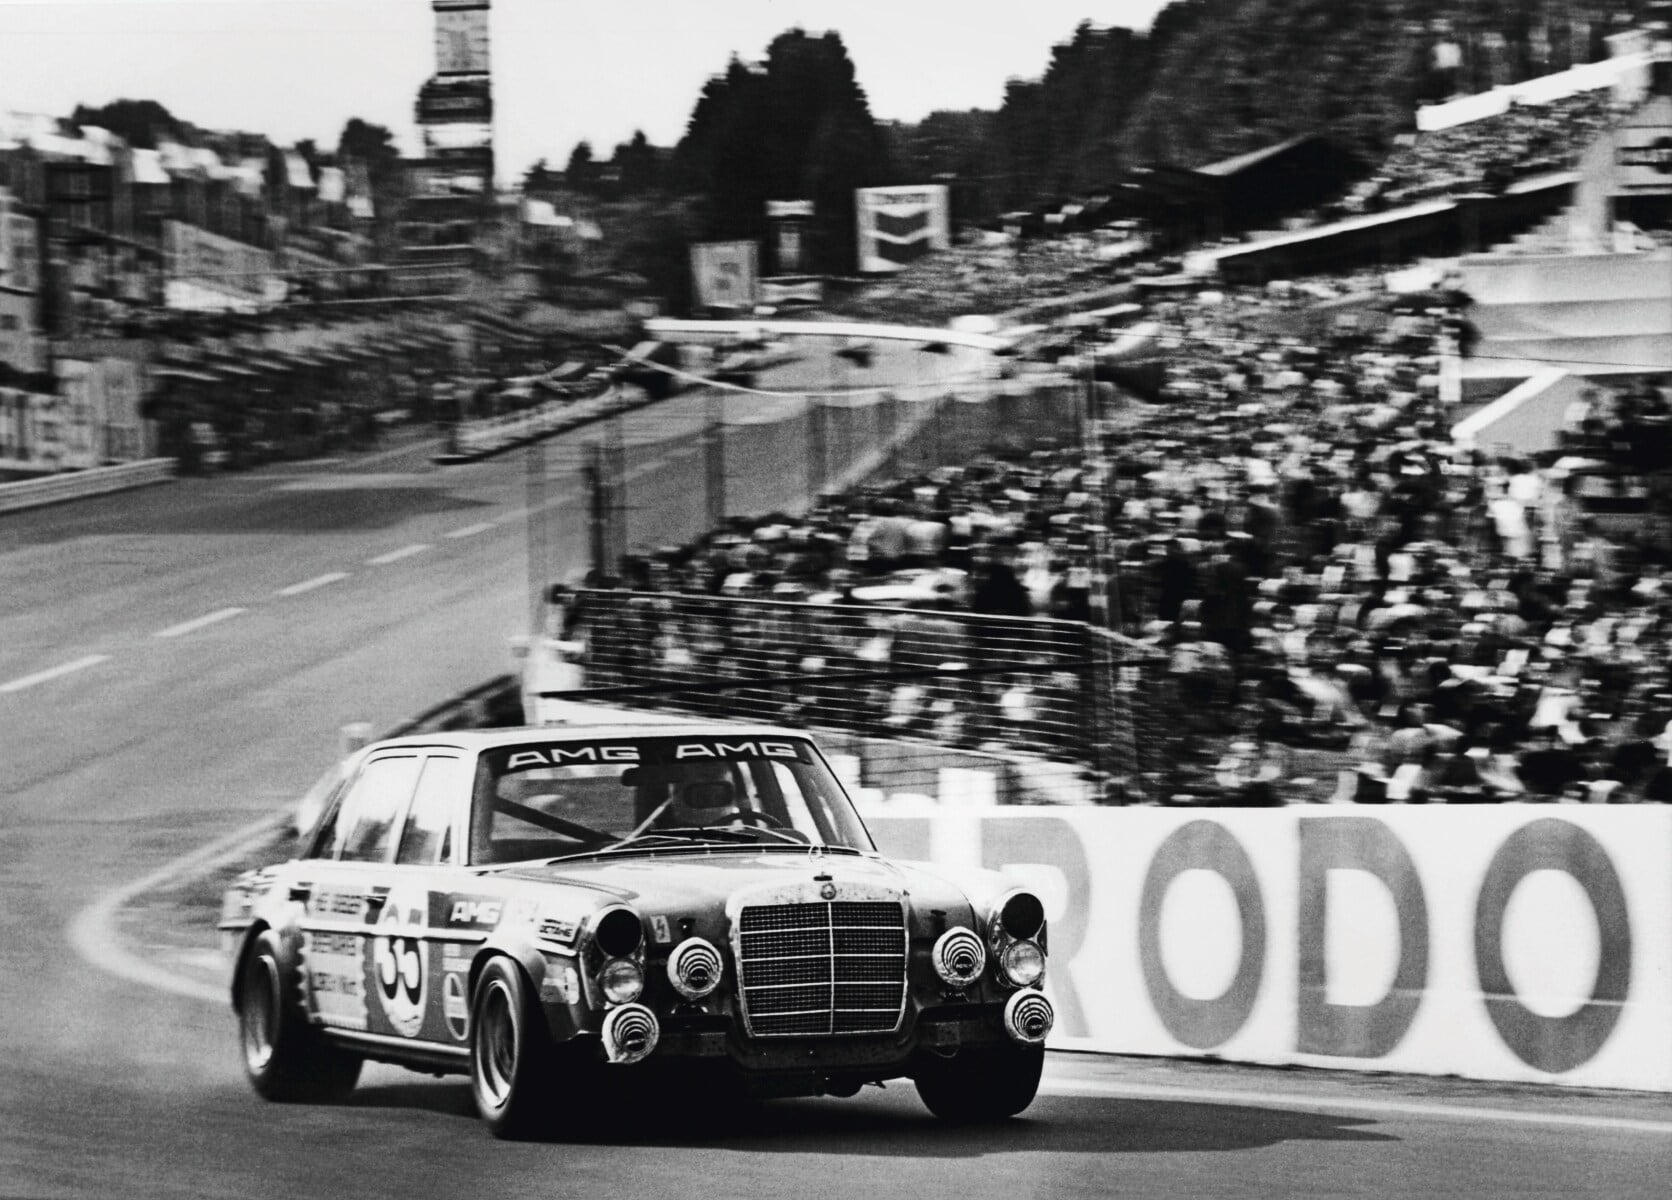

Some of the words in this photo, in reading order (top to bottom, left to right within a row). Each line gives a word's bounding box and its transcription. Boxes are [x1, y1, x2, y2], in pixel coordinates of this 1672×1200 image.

[508, 746, 640, 769] AMG
[676, 742, 798, 759] AMG
[450, 901, 502, 925] AMG
[864, 815, 1634, 1074] RODO
[377, 903, 422, 1006] 35
